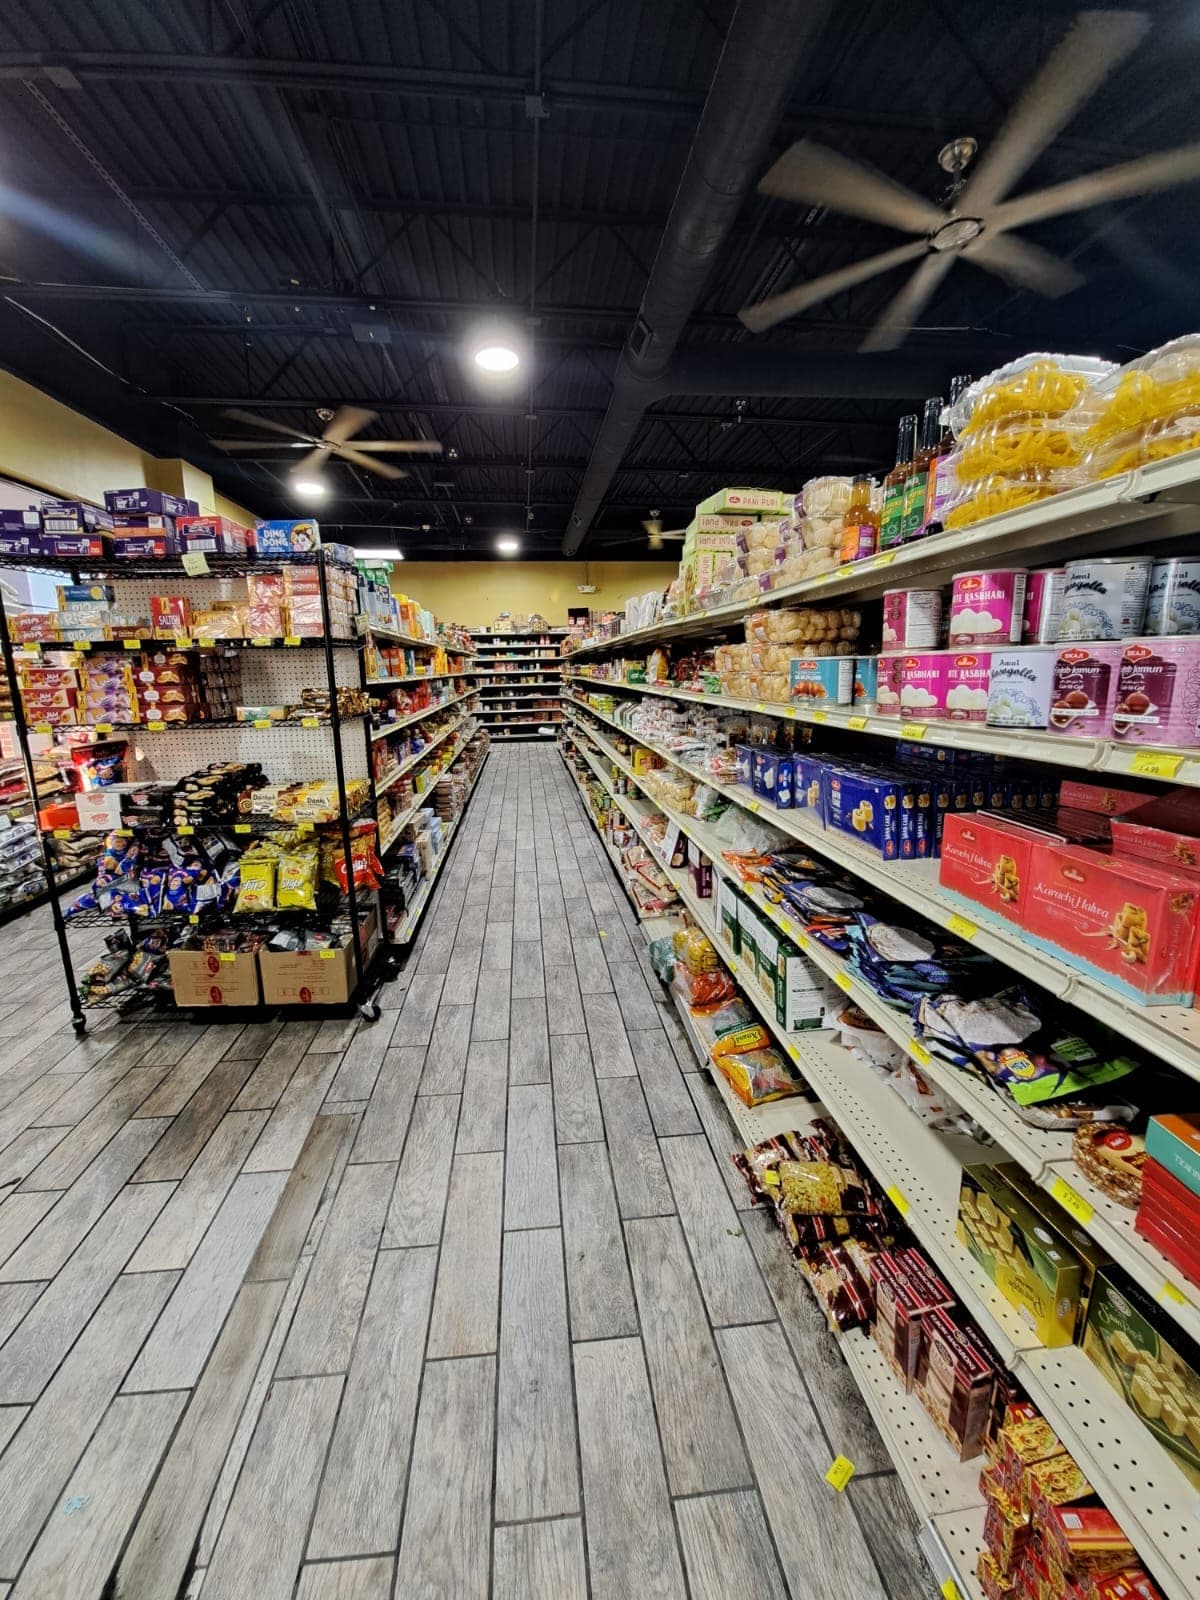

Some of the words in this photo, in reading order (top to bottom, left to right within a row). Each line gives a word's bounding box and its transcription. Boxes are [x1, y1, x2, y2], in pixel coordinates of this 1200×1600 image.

[263, 529, 285, 538] DING
[262, 538, 288, 547] DONG
[963, 590, 1005, 603] RASBHARI
[960, 669, 991, 680] RASBHA
[1034, 882, 1075, 908] Karachi
[1073, 896, 1109, 919] Halwa
[930, 1314, 949, 1335] ELBOW
[947, 1335, 976, 1370] MACARONI
